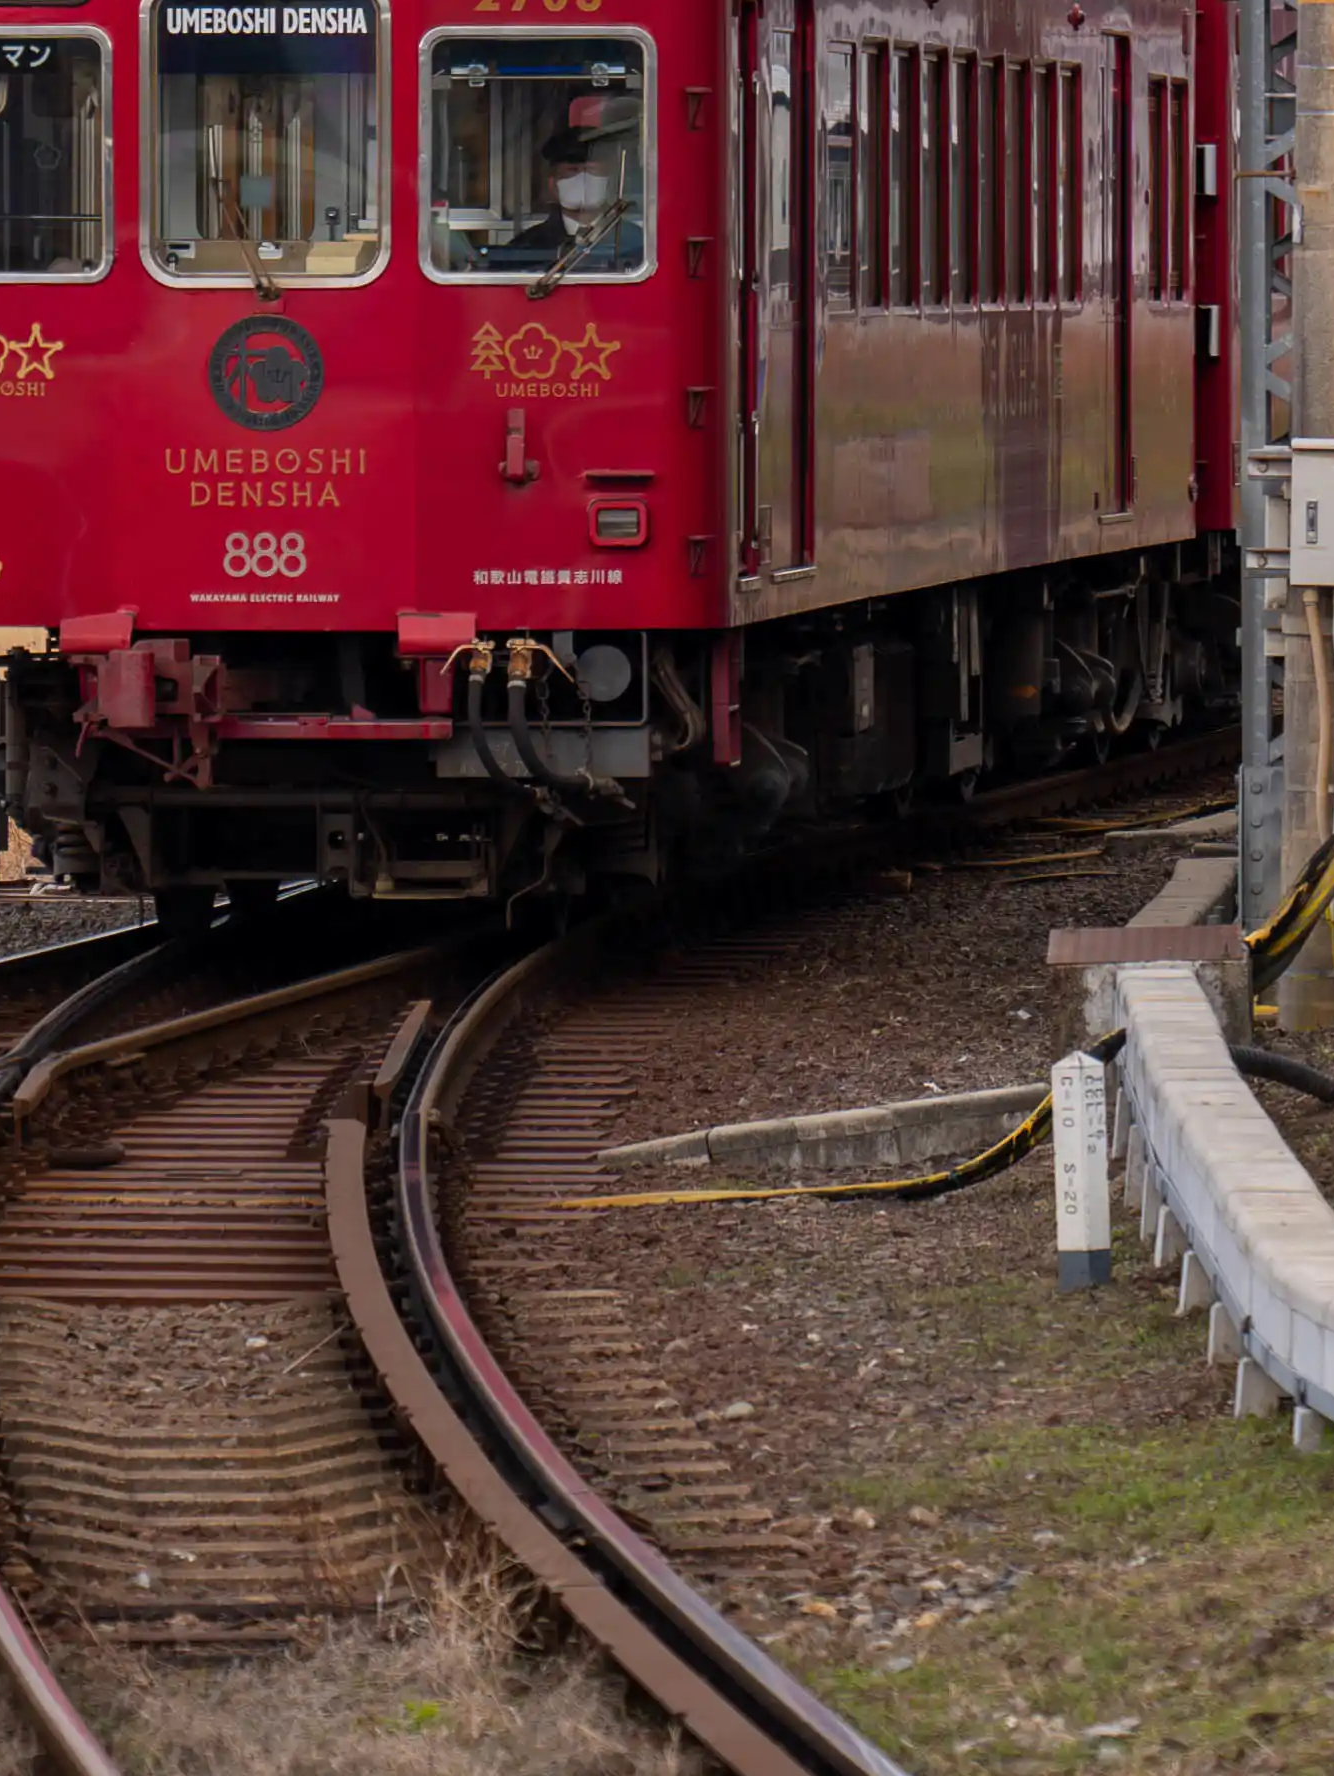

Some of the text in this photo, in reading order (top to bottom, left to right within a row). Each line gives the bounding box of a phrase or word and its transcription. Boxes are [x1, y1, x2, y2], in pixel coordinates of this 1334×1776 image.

[166, 7, 368, 35] UMEBOSHI DENSHA
[495, 382, 599, 398] UMEBOSHI
[165, 447, 367, 475] UMEBOSHI
[190, 480, 341, 507] DENSHA
[223, 531, 307, 578] 888
[190, 594, 340, 603] WAKAYAMA ELECTRIC RAILWAY
